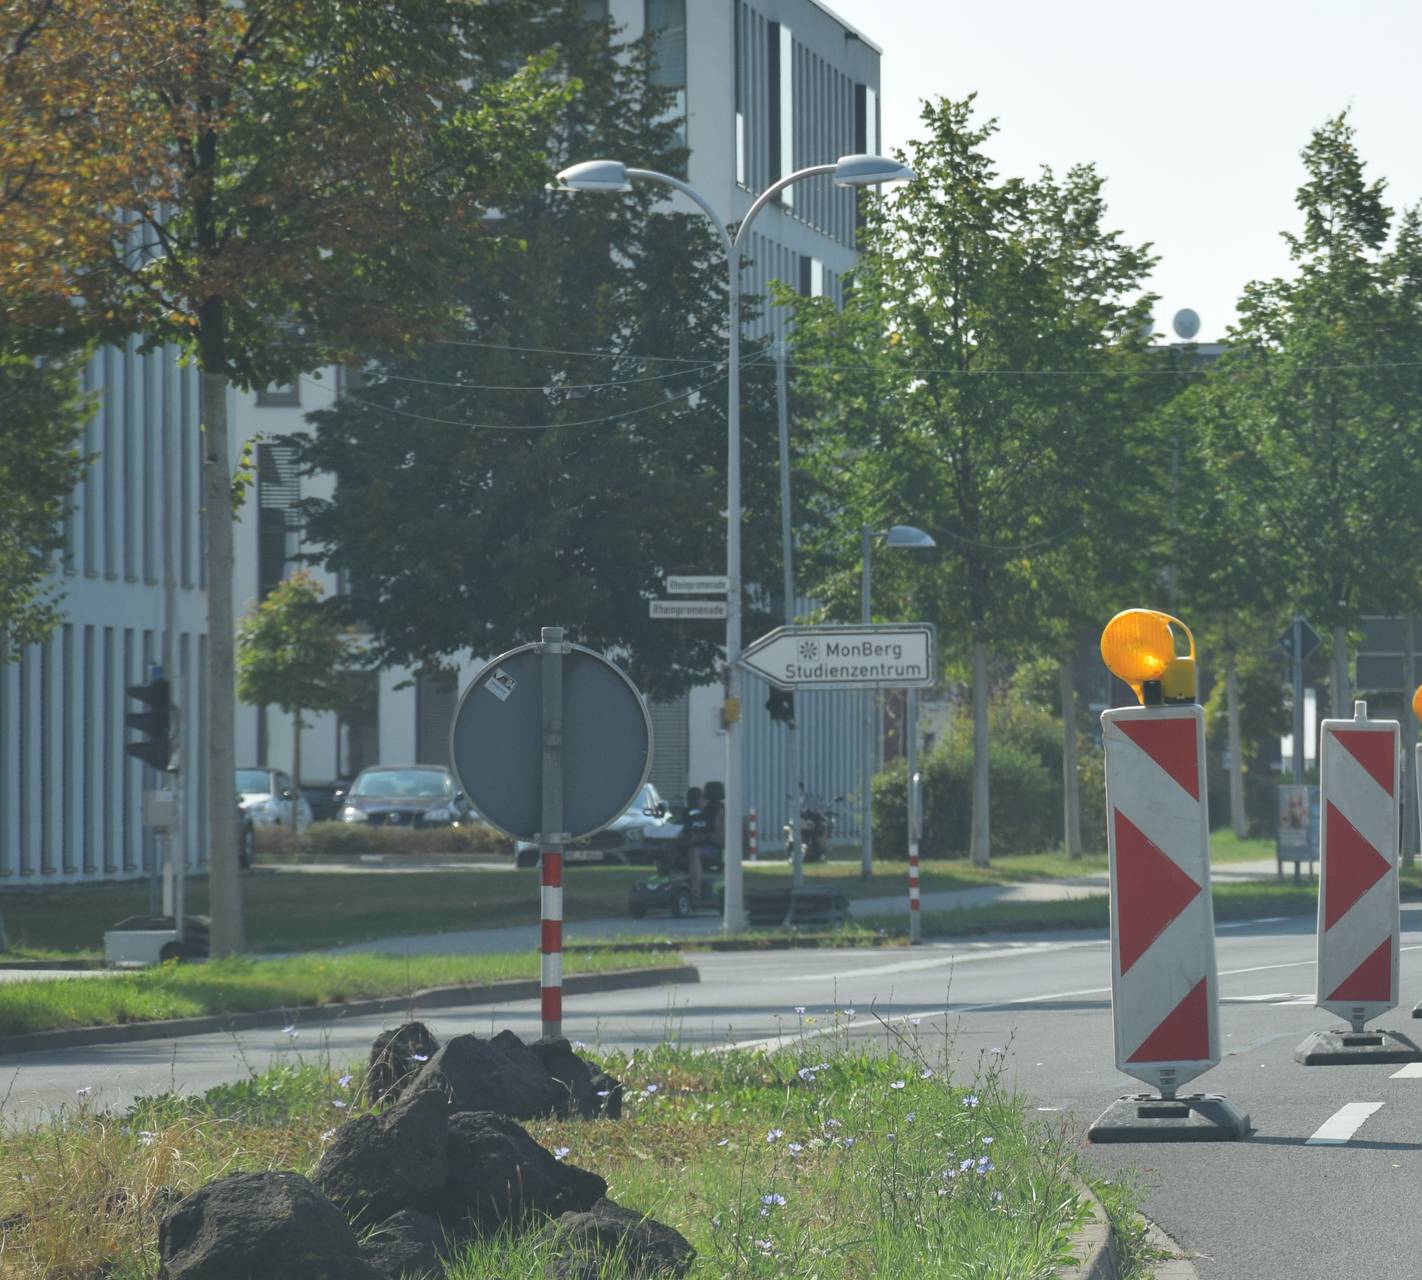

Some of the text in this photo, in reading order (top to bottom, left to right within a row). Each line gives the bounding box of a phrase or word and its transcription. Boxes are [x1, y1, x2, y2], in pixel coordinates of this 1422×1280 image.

[653, 603, 724, 617] Rheinpromenade
[825, 641, 903, 660] MonBerg
[785, 662, 922, 679] Studienzentrum
